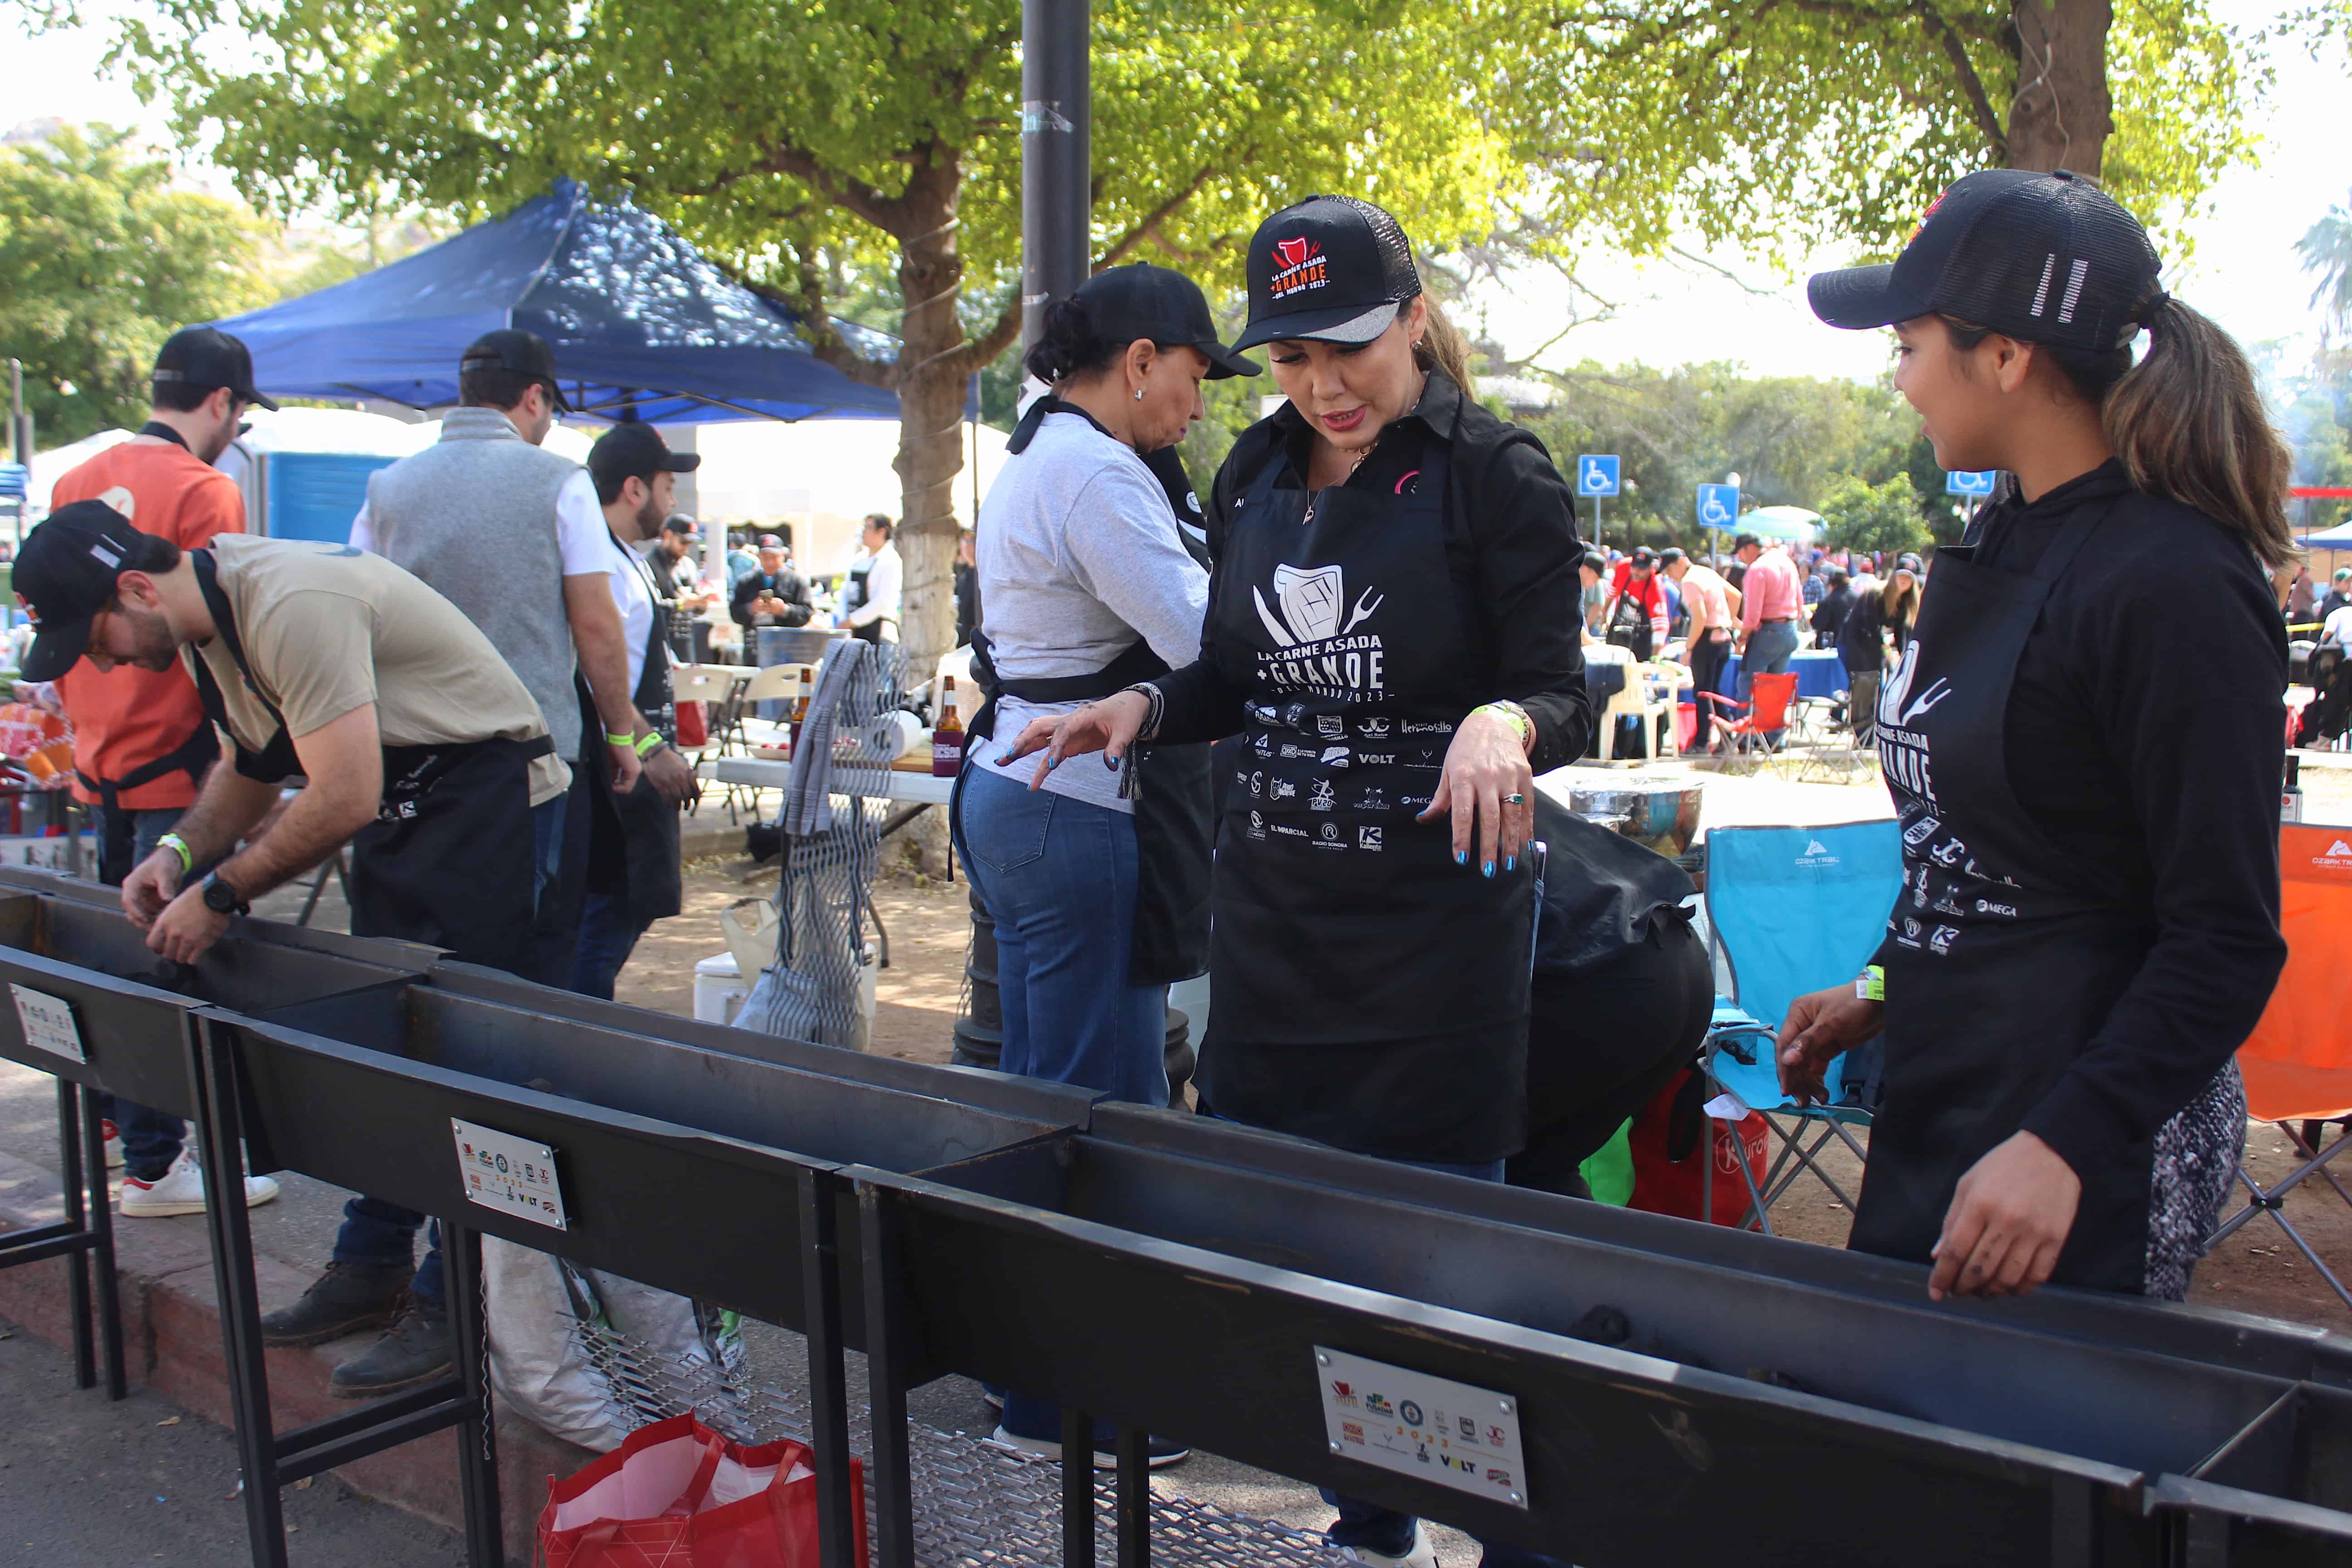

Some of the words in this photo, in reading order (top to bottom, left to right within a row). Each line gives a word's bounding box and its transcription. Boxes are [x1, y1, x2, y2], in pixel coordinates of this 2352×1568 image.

[1280, 264, 1301, 278] CARNE
[1303, 255, 1327, 269] ASADA
[1286, 284, 1305, 295] MUNDO
[1257, 652, 1274, 661] LA
[1275, 643, 1320, 661] CARNE
[1325, 635, 1382, 653] ASADA
[1308, 686, 1342, 699] MUNDO
[1401, 719, 1452, 733] Hermosillo
[1897, 729, 1929, 752] ASADA
[1358, 754, 1396, 764] VOLT
[1278, 826, 1309, 837] IMPARCIAL
[1989, 903, 2017, 916] MEGA
[519, 1194, 537, 1206] VOLT
[1440, 1453, 1475, 1474] VOLT
